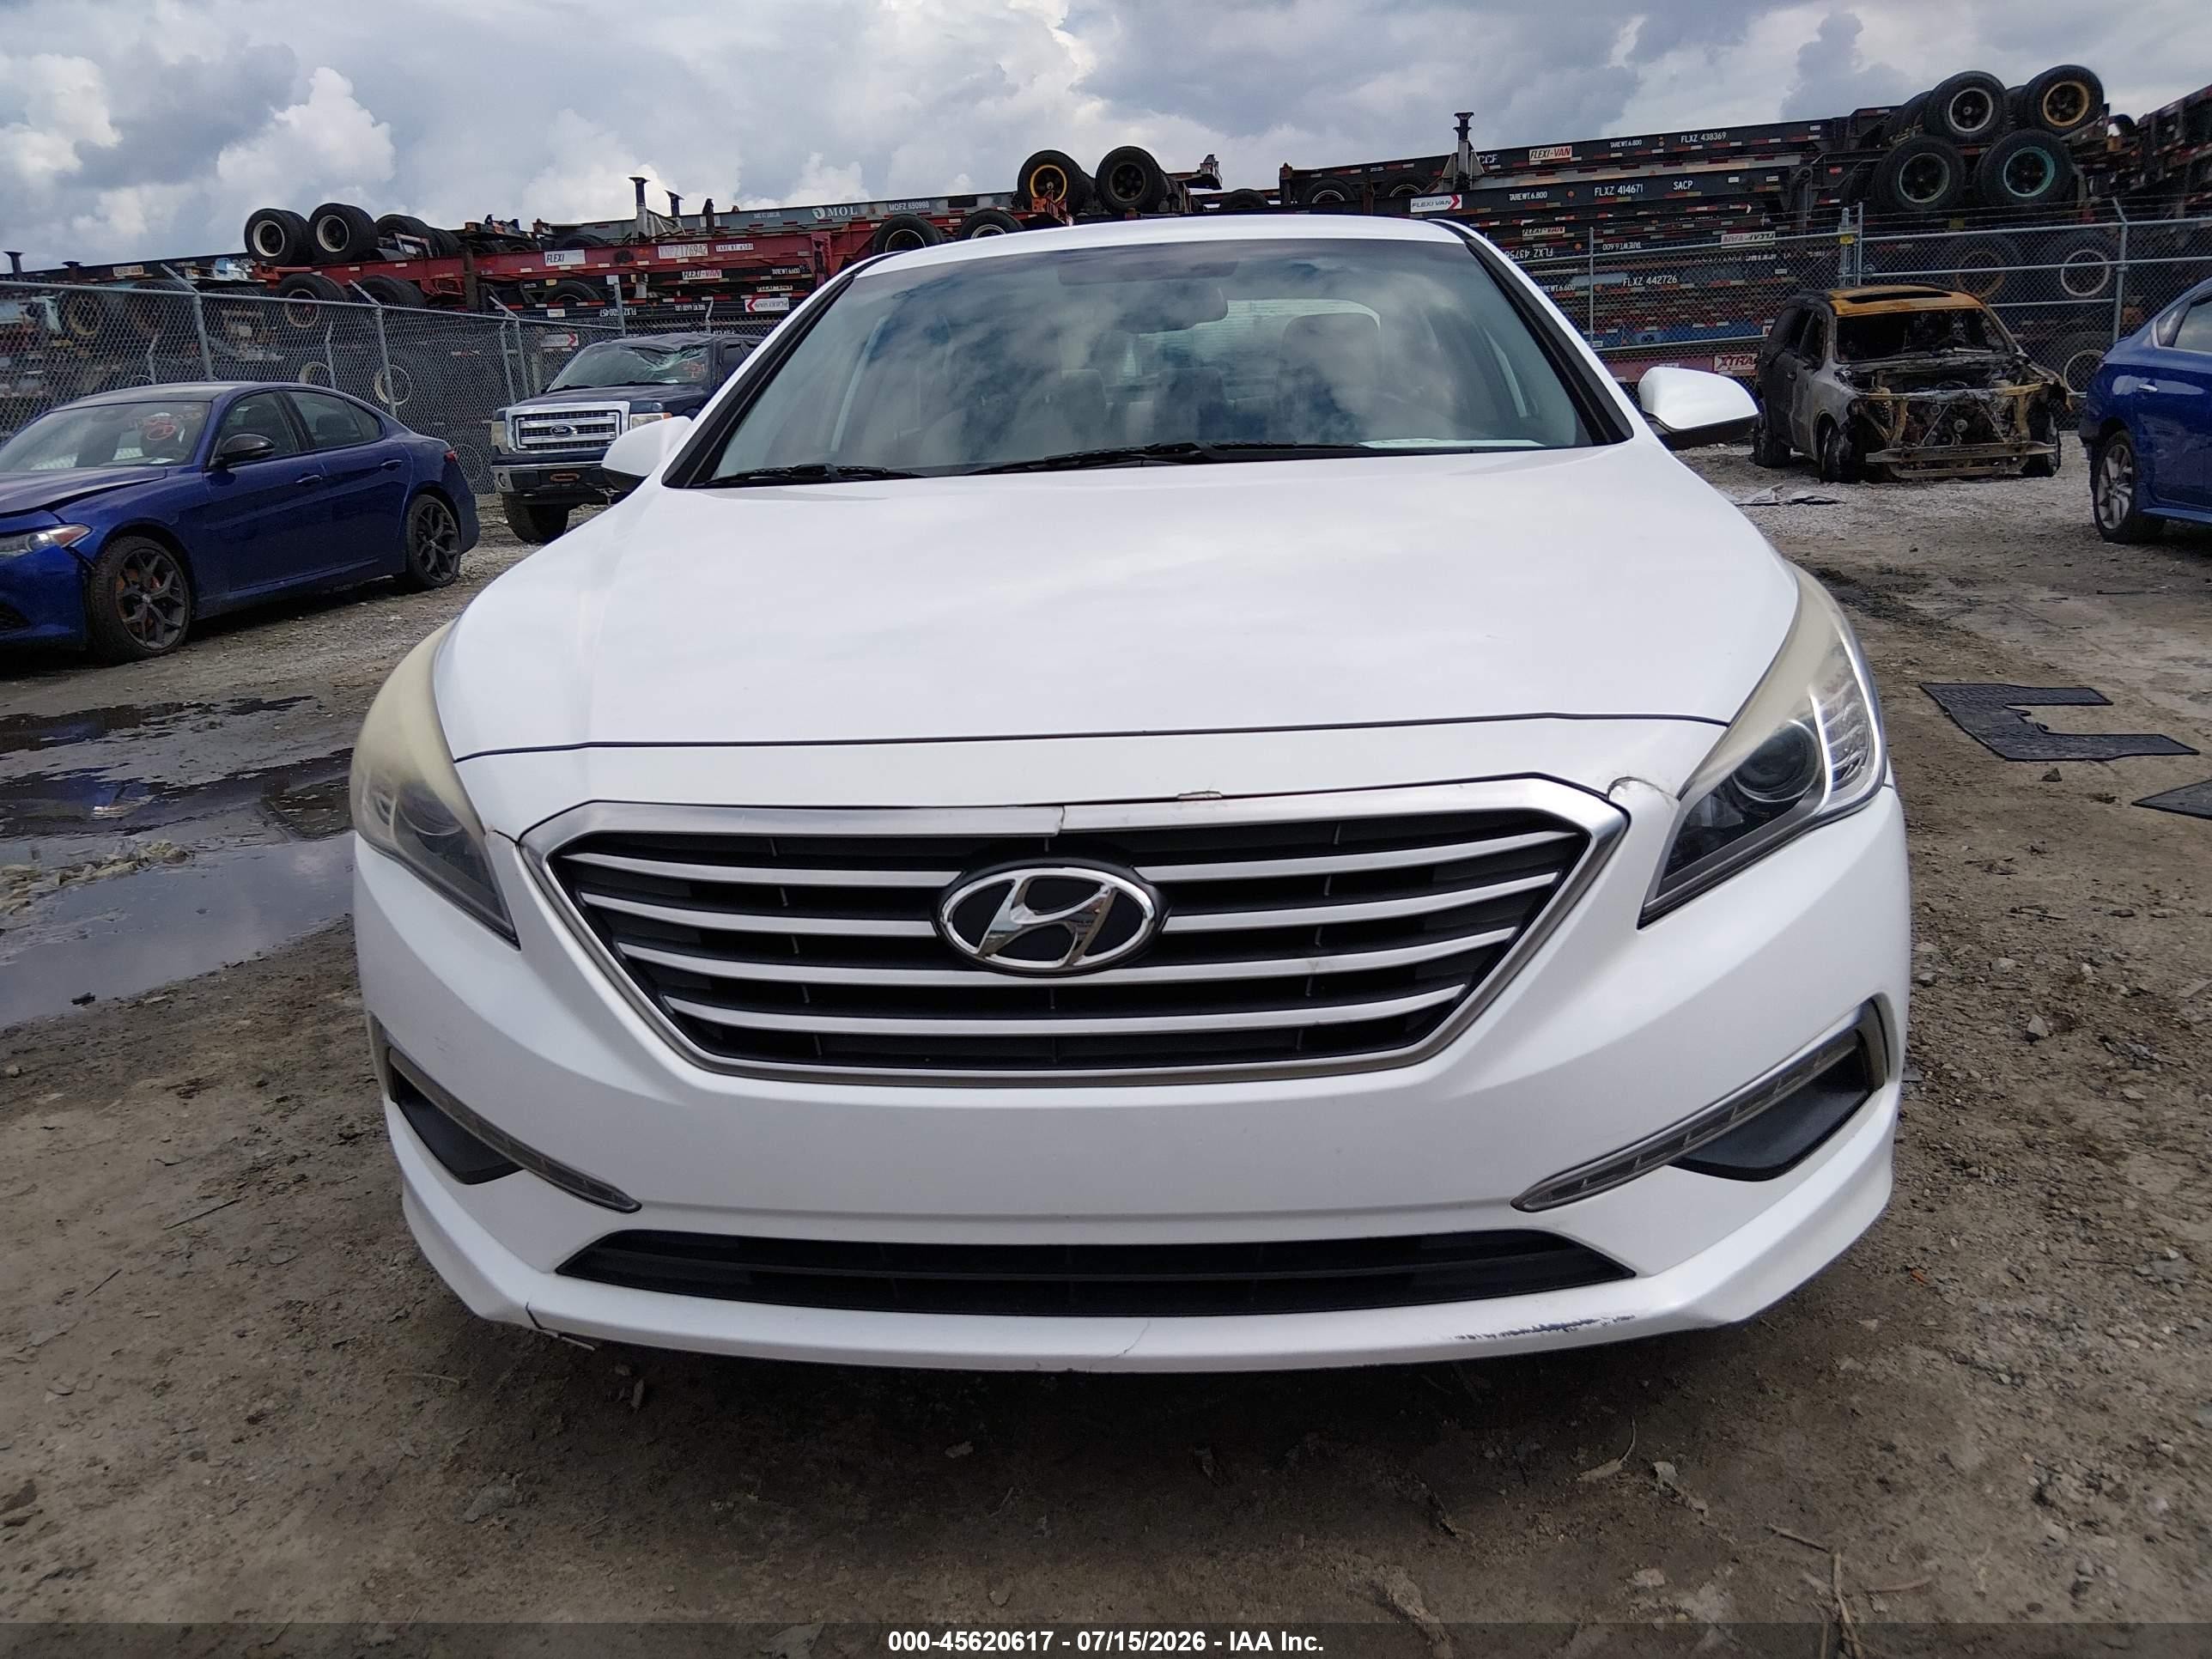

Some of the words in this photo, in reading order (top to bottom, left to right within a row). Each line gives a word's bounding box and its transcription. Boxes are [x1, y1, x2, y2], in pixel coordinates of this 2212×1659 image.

[1680, 135, 1698, 143] FLXZ
[1701, 131, 1727, 141] 438369
[1595, 185, 1614, 196] FLXZ
[1618, 183, 1643, 195] 414671
[1674, 180, 1692, 191] SACP
[827, 206, 858, 216] MOL
[546, 253, 564, 263] FLEXI
[1533, 247, 1553, 258] FLXZ
[1623, 276, 1643, 287] FLXZ
[1646, 275, 1677, 285] 442726
